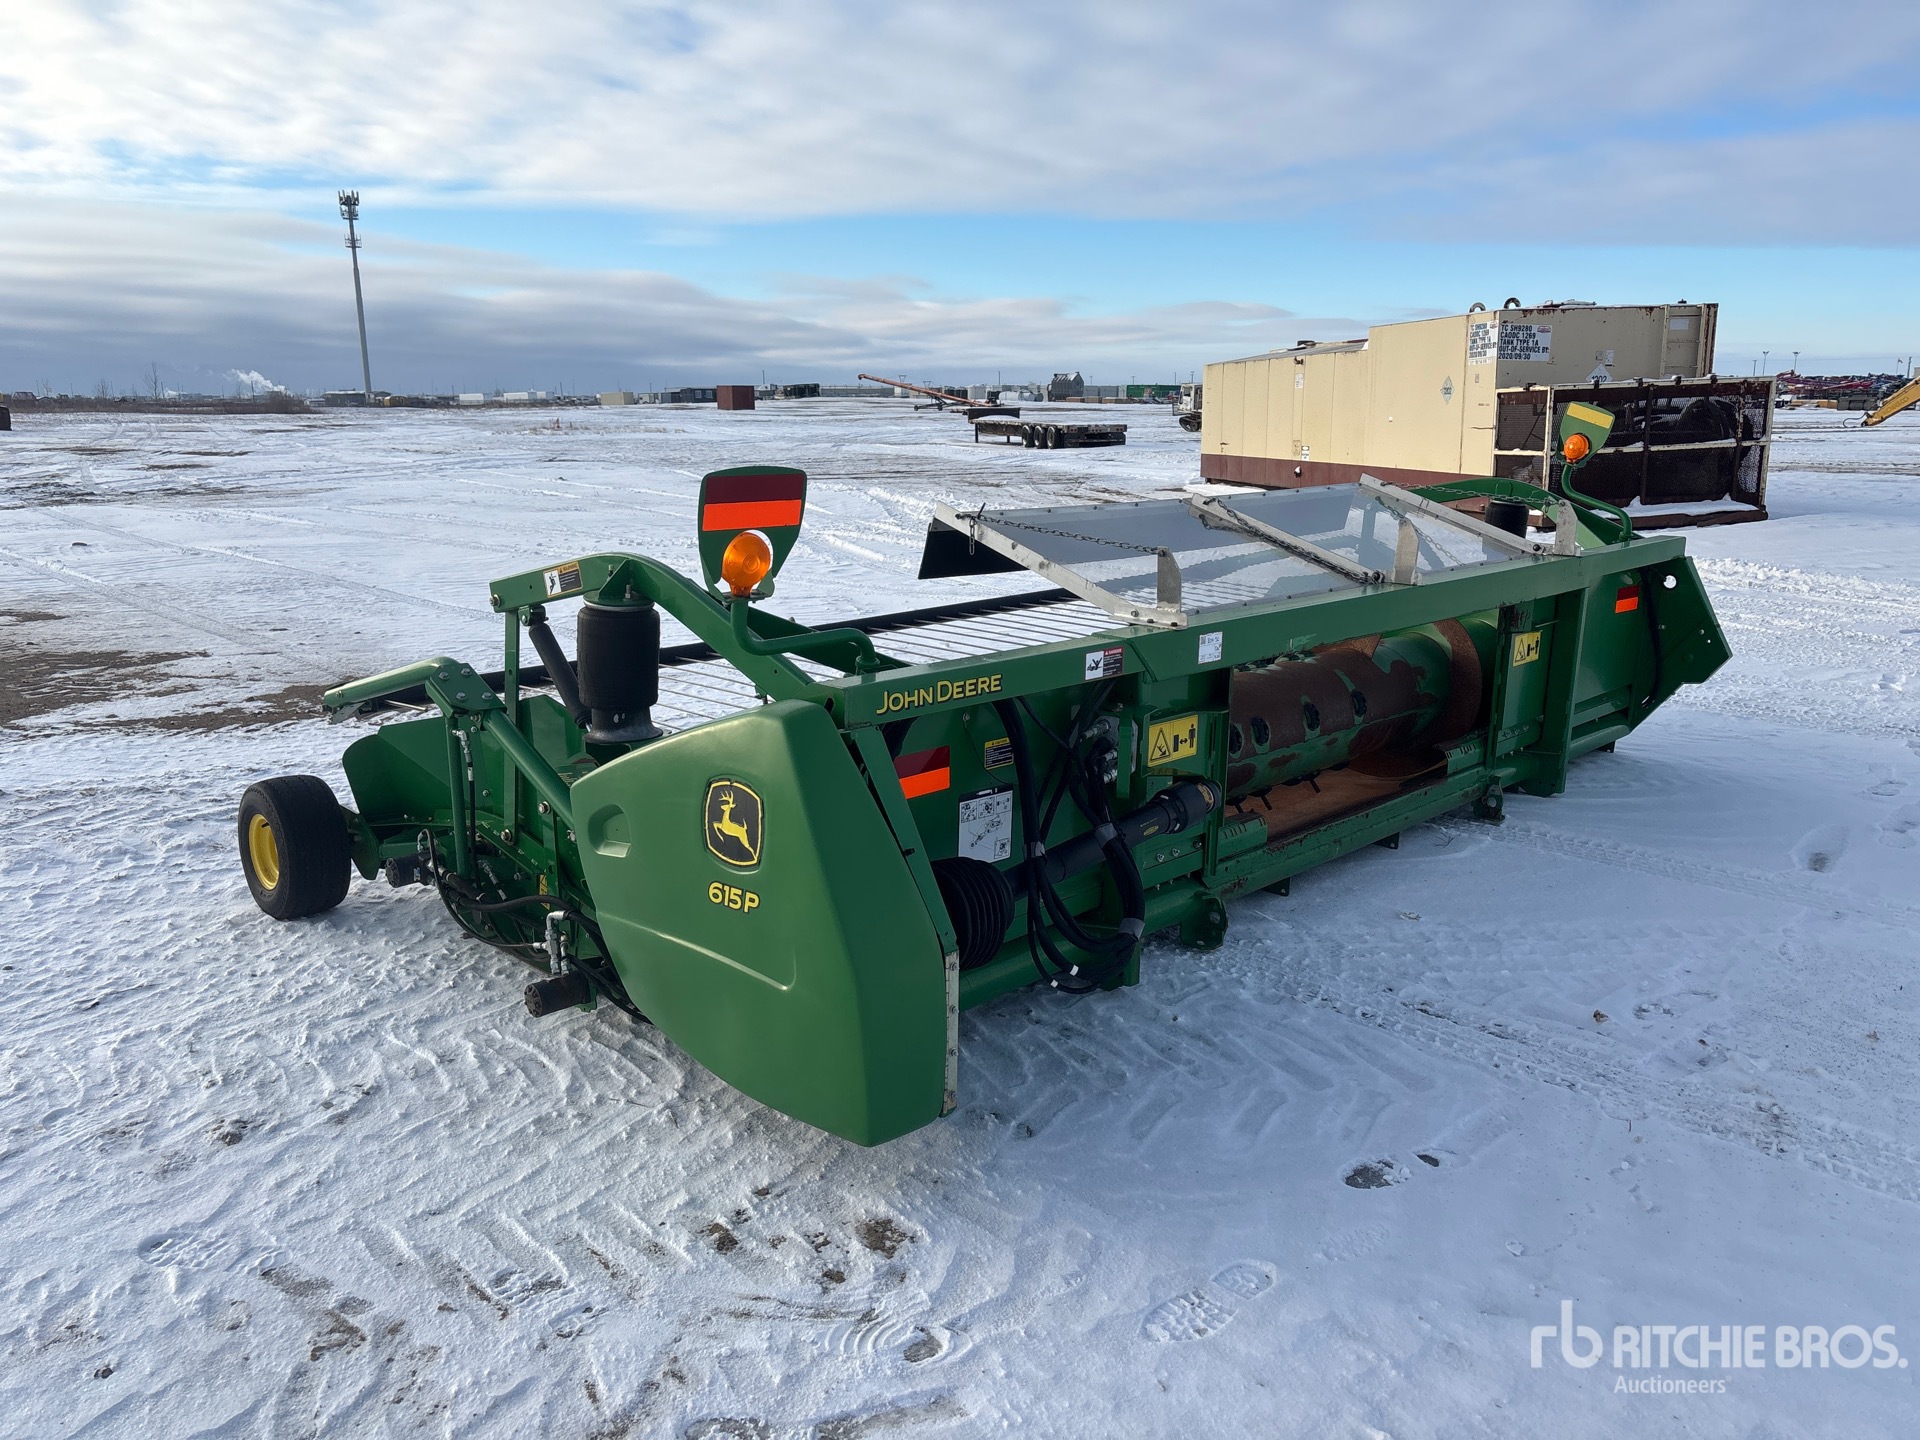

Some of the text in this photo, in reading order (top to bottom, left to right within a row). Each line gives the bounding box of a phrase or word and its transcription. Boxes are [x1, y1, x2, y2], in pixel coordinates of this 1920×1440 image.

[1499, 345, 1540, 353] OUT-OF-SERVICE
[876, 674, 1002, 715] JOHN DEERE
[708, 881, 760, 914] 615P
